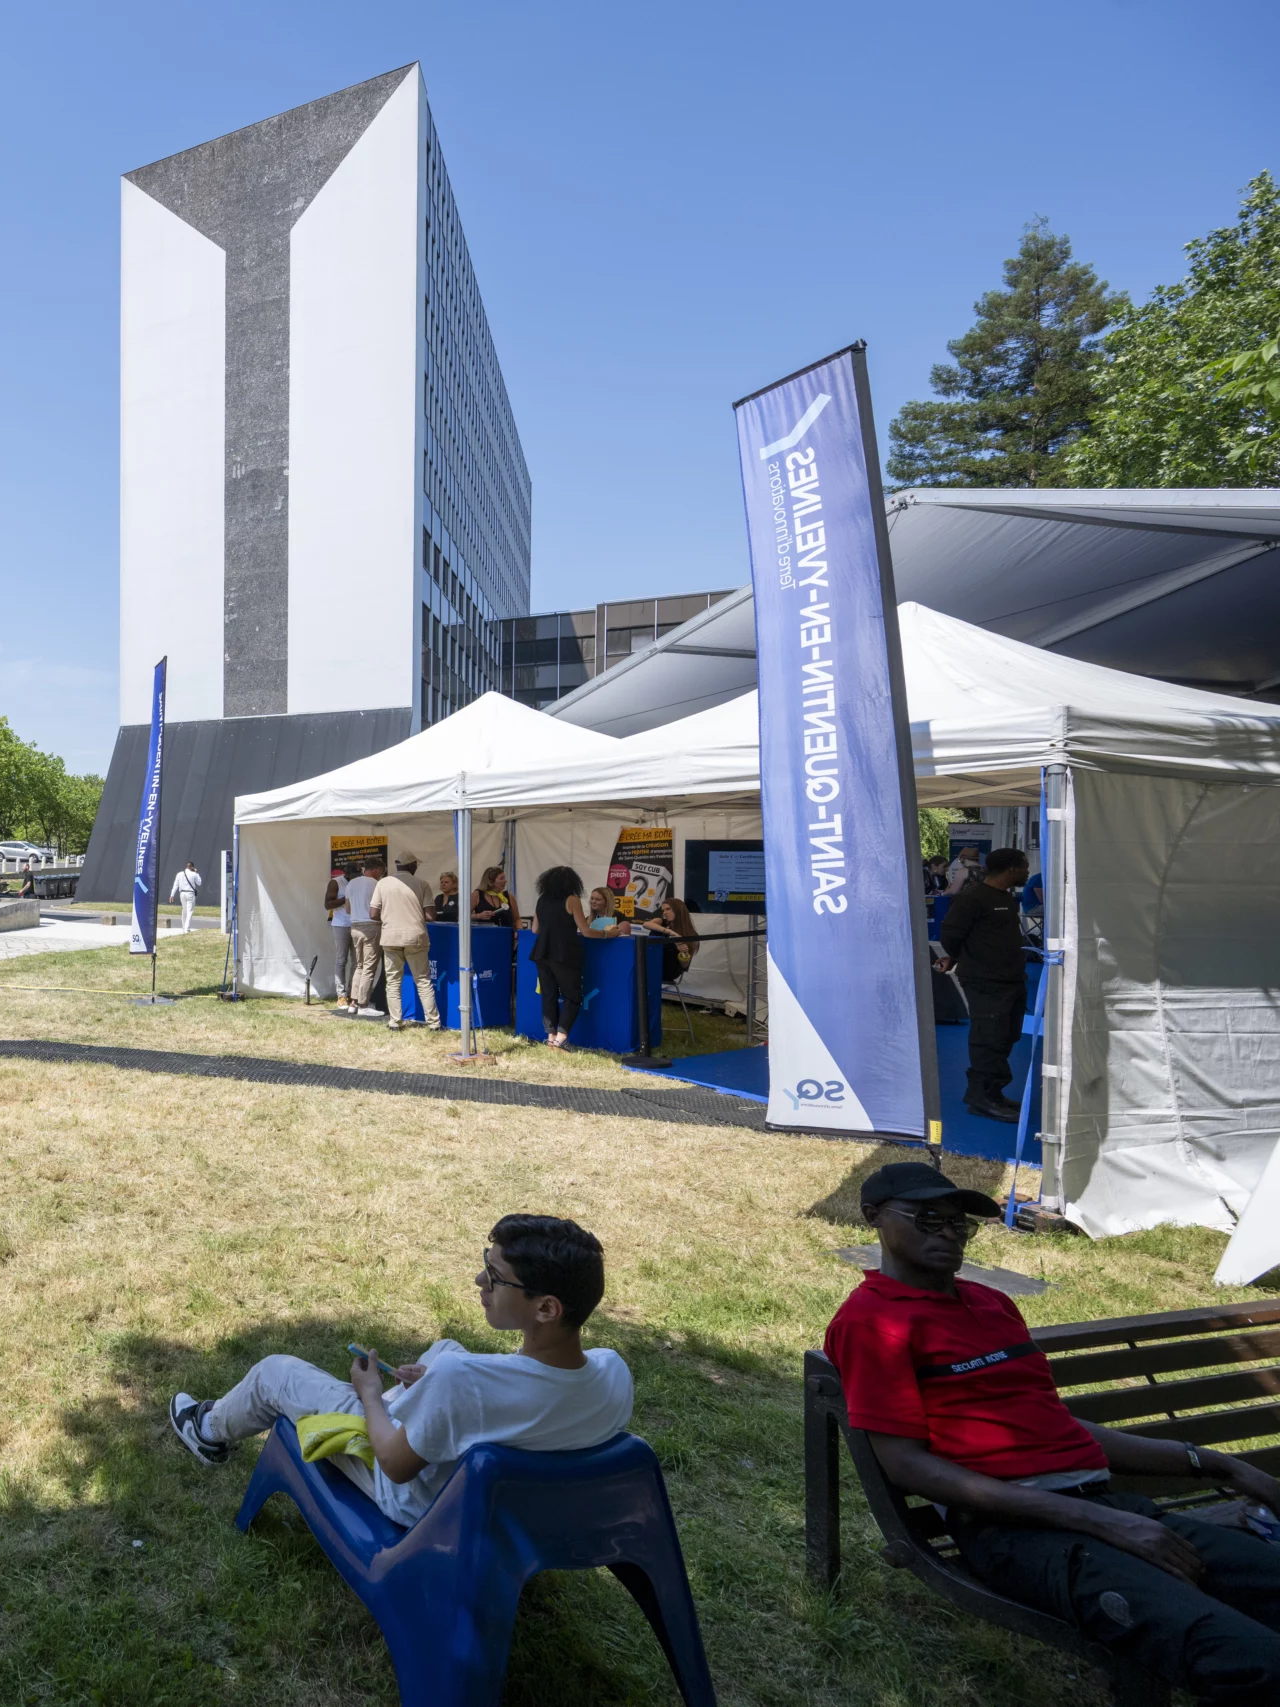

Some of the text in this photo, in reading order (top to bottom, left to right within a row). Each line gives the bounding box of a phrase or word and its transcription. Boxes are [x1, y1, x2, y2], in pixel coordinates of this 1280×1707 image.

[645, 841, 669, 849] création
[635, 863, 648, 871] SQY
[647, 865, 660, 874] CUB
